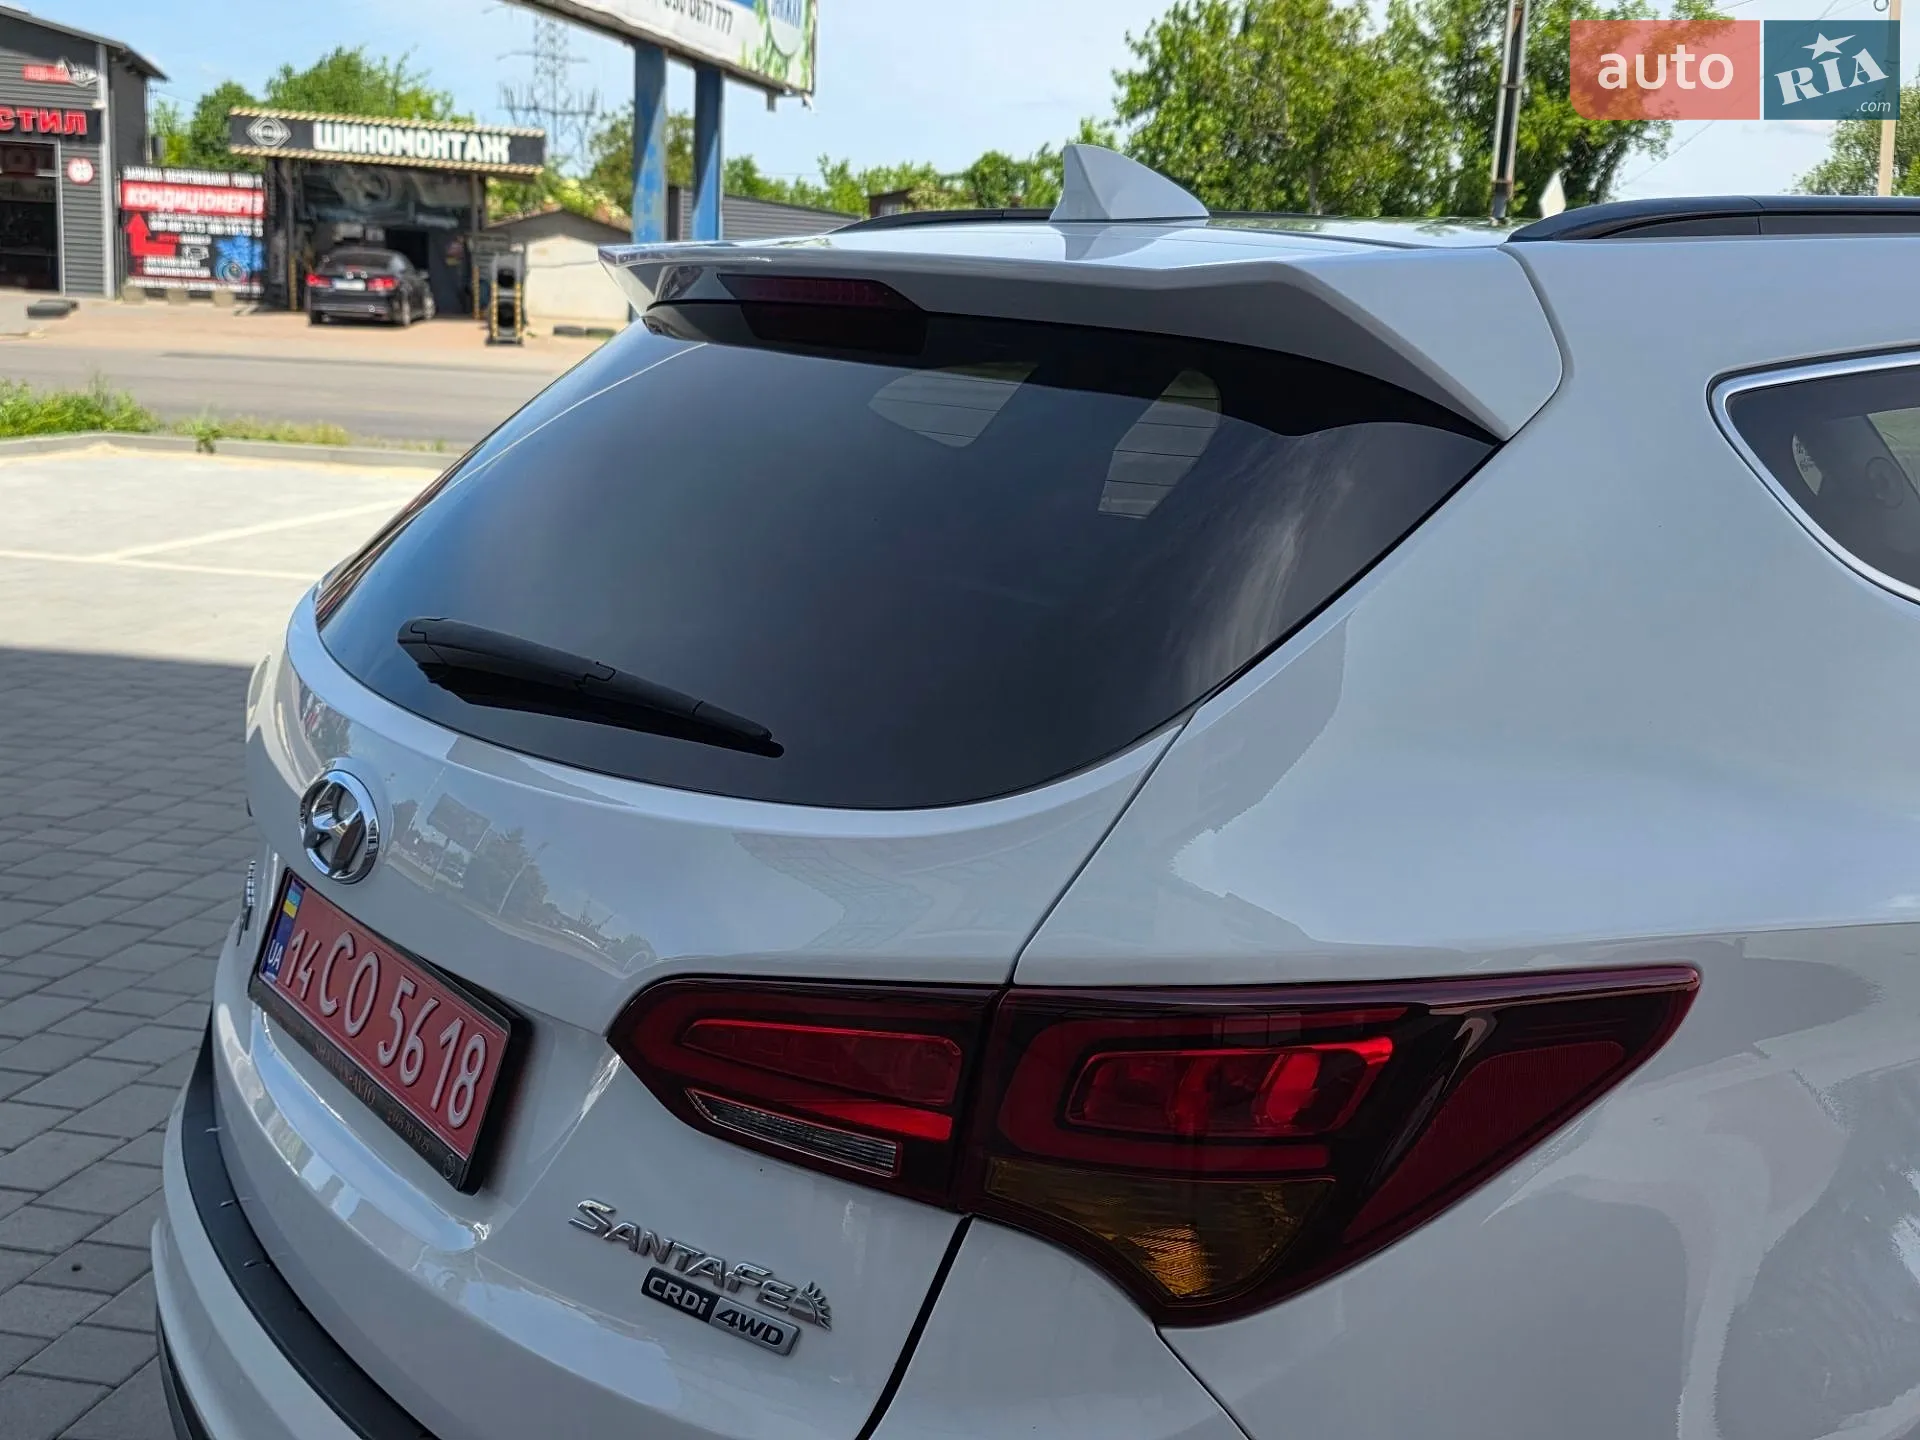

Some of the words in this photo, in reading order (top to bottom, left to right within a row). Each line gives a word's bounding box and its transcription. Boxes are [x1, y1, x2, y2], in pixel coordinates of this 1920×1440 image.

[313, 122, 511, 164] ШИНОМОНТАЖ
[268, 939, 283, 972] UA
[378, 974, 486, 1129] 5618
[648, 1276, 711, 1315] CRDi
[716, 1308, 784, 1347] 4WD
